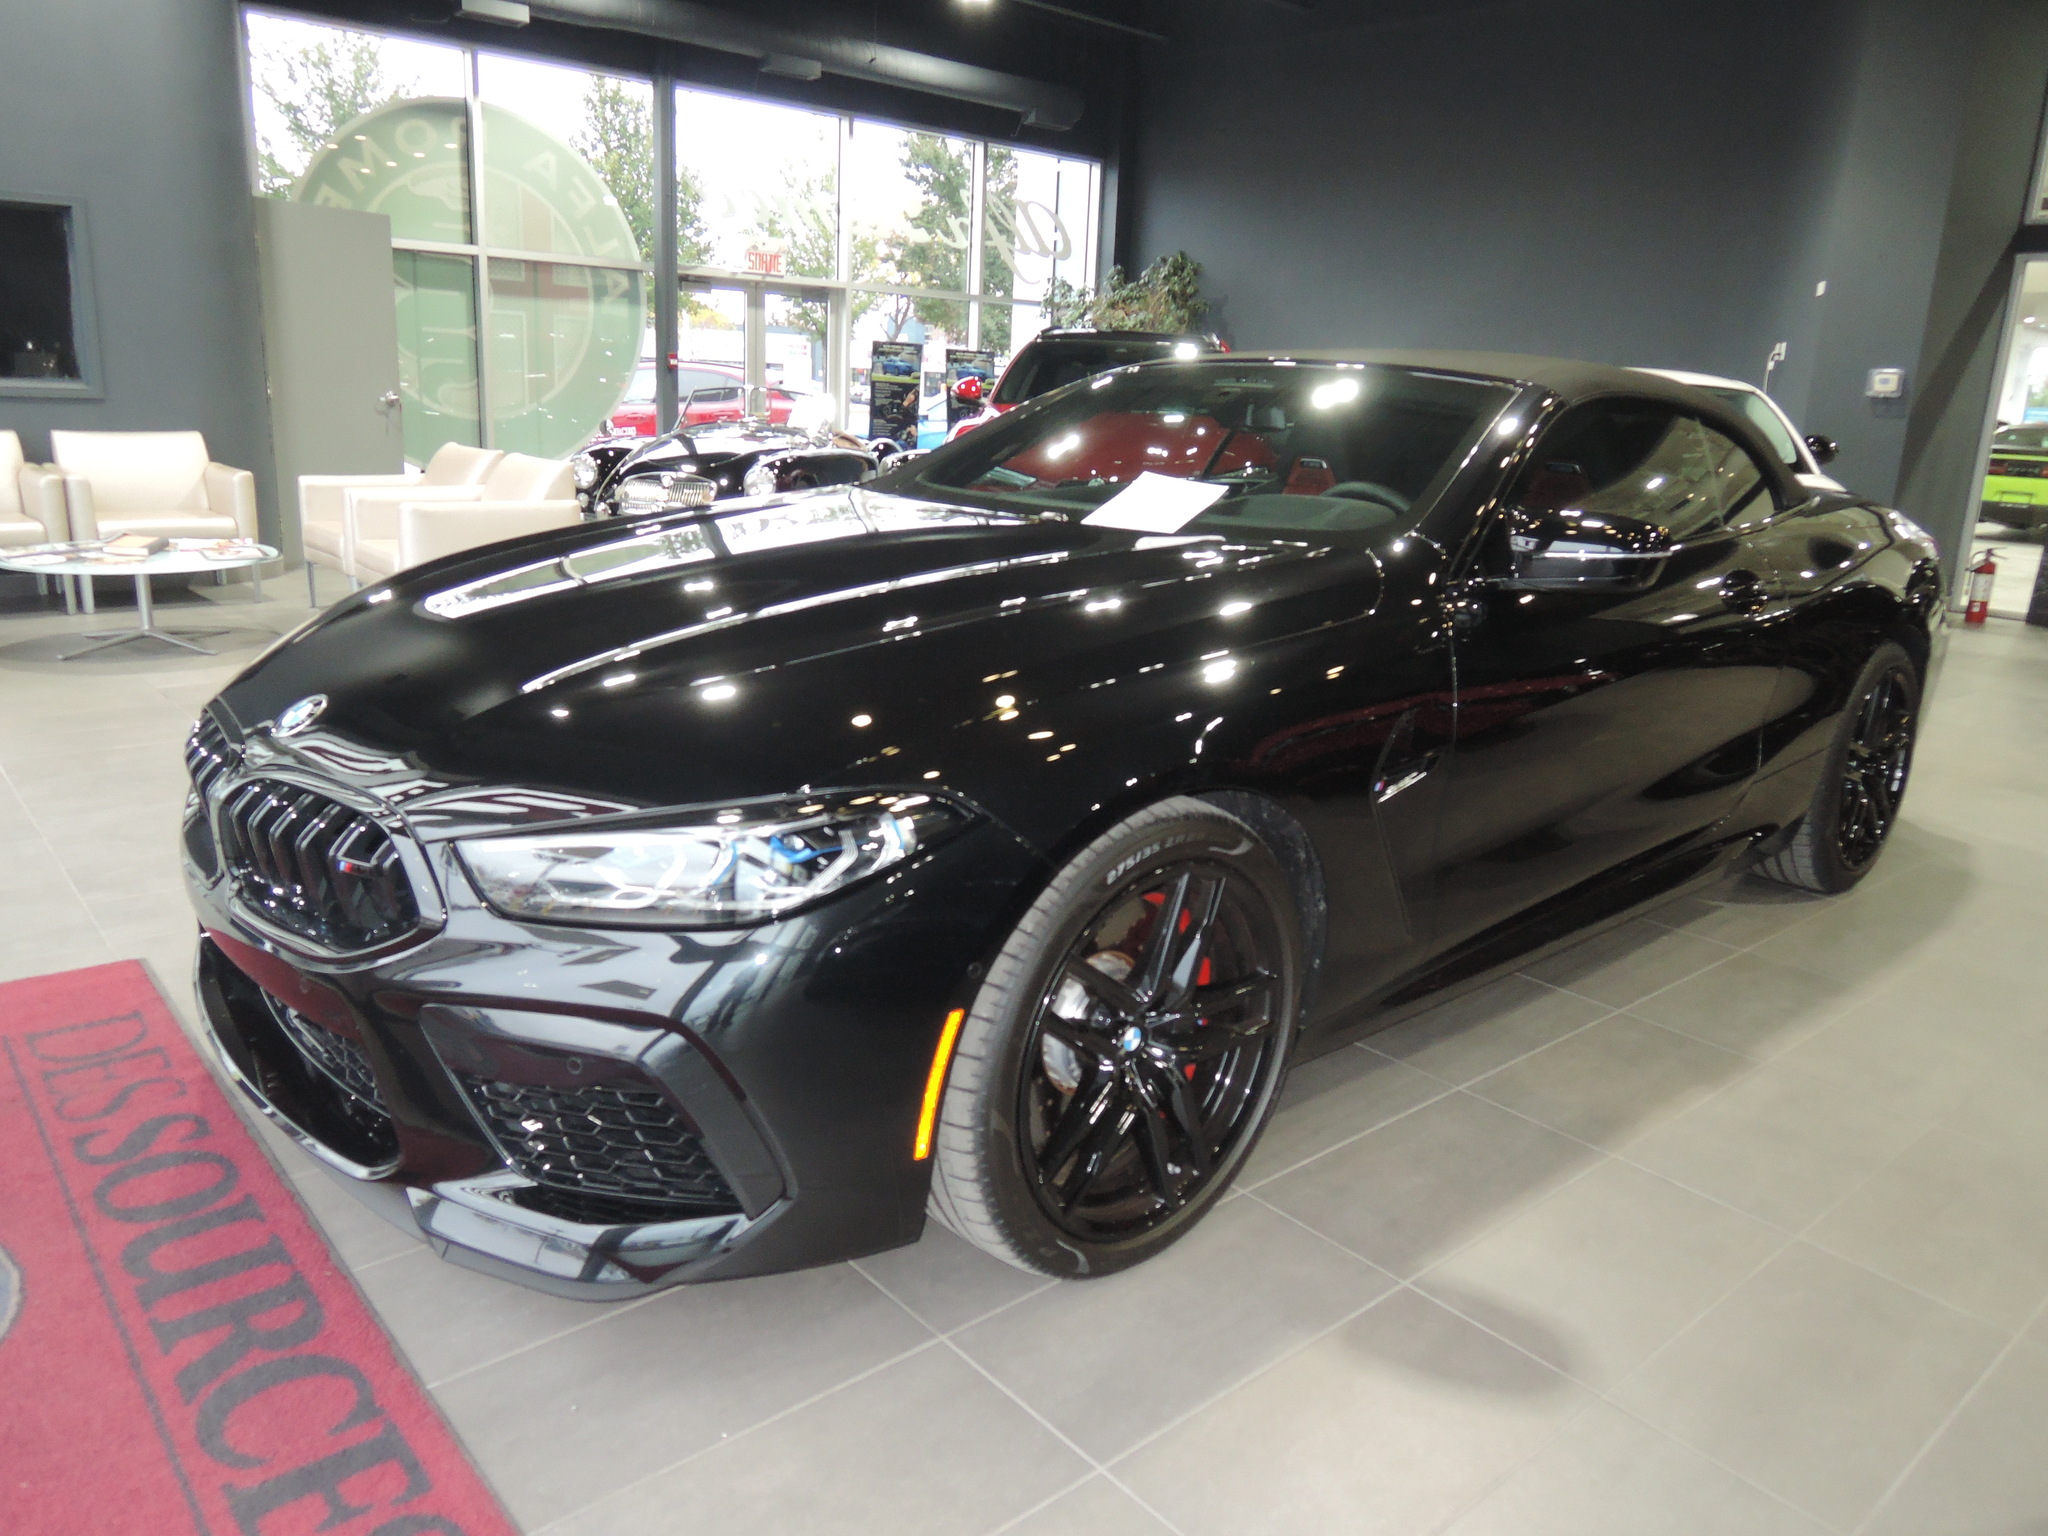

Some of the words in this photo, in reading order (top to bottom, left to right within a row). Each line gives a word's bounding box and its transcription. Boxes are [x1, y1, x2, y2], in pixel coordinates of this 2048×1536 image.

[748, 252, 782, 273] SORTIE
[25, 1010, 188, 1123] DES
[68, 1113, 471, 1536] SOURCE
